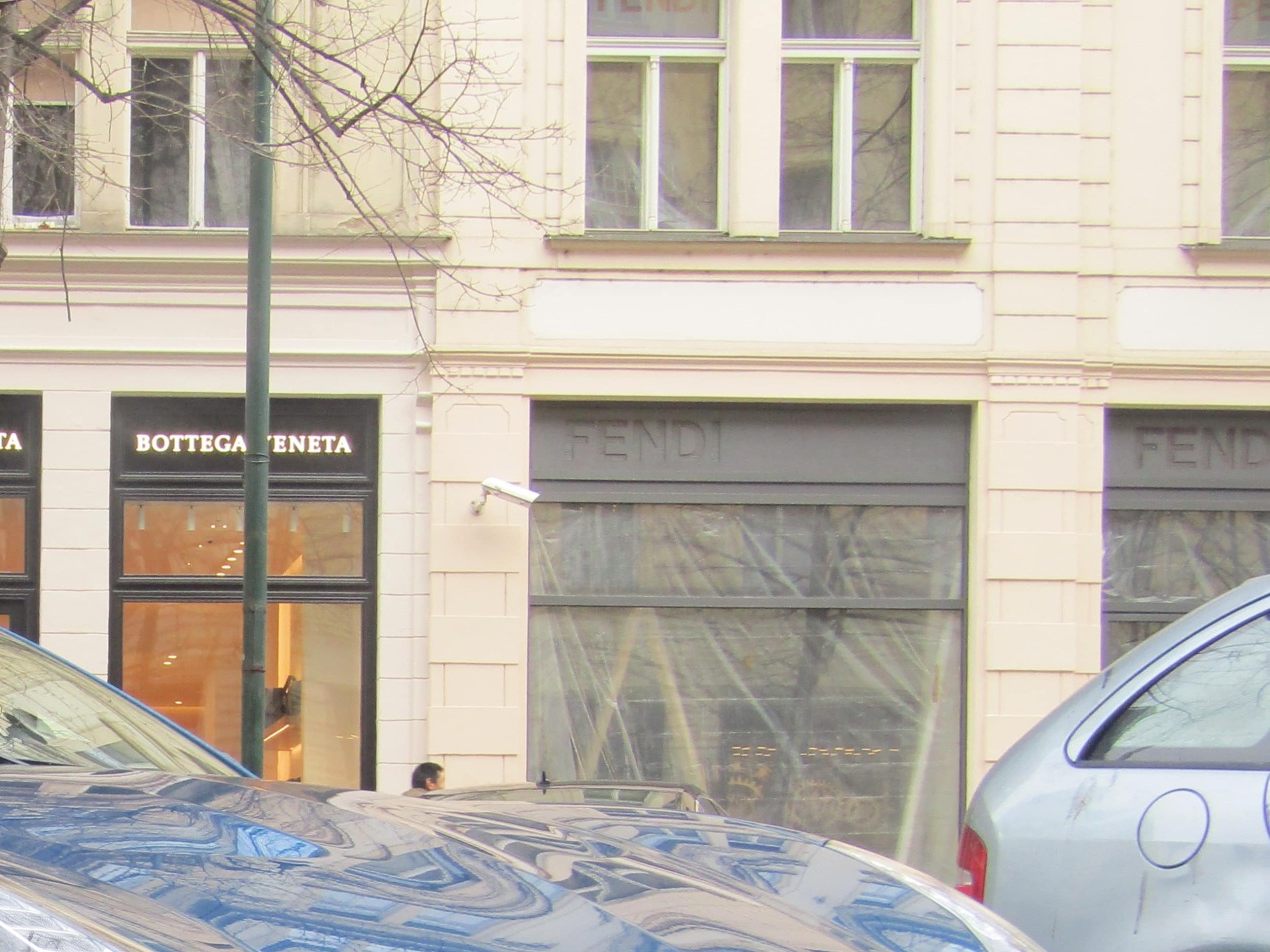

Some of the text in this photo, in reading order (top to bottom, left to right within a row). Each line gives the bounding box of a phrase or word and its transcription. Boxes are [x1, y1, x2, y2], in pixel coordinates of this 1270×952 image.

[136, 433, 352, 453] BOTTEGA ENETA
[565, 419, 721, 462] FENDI
